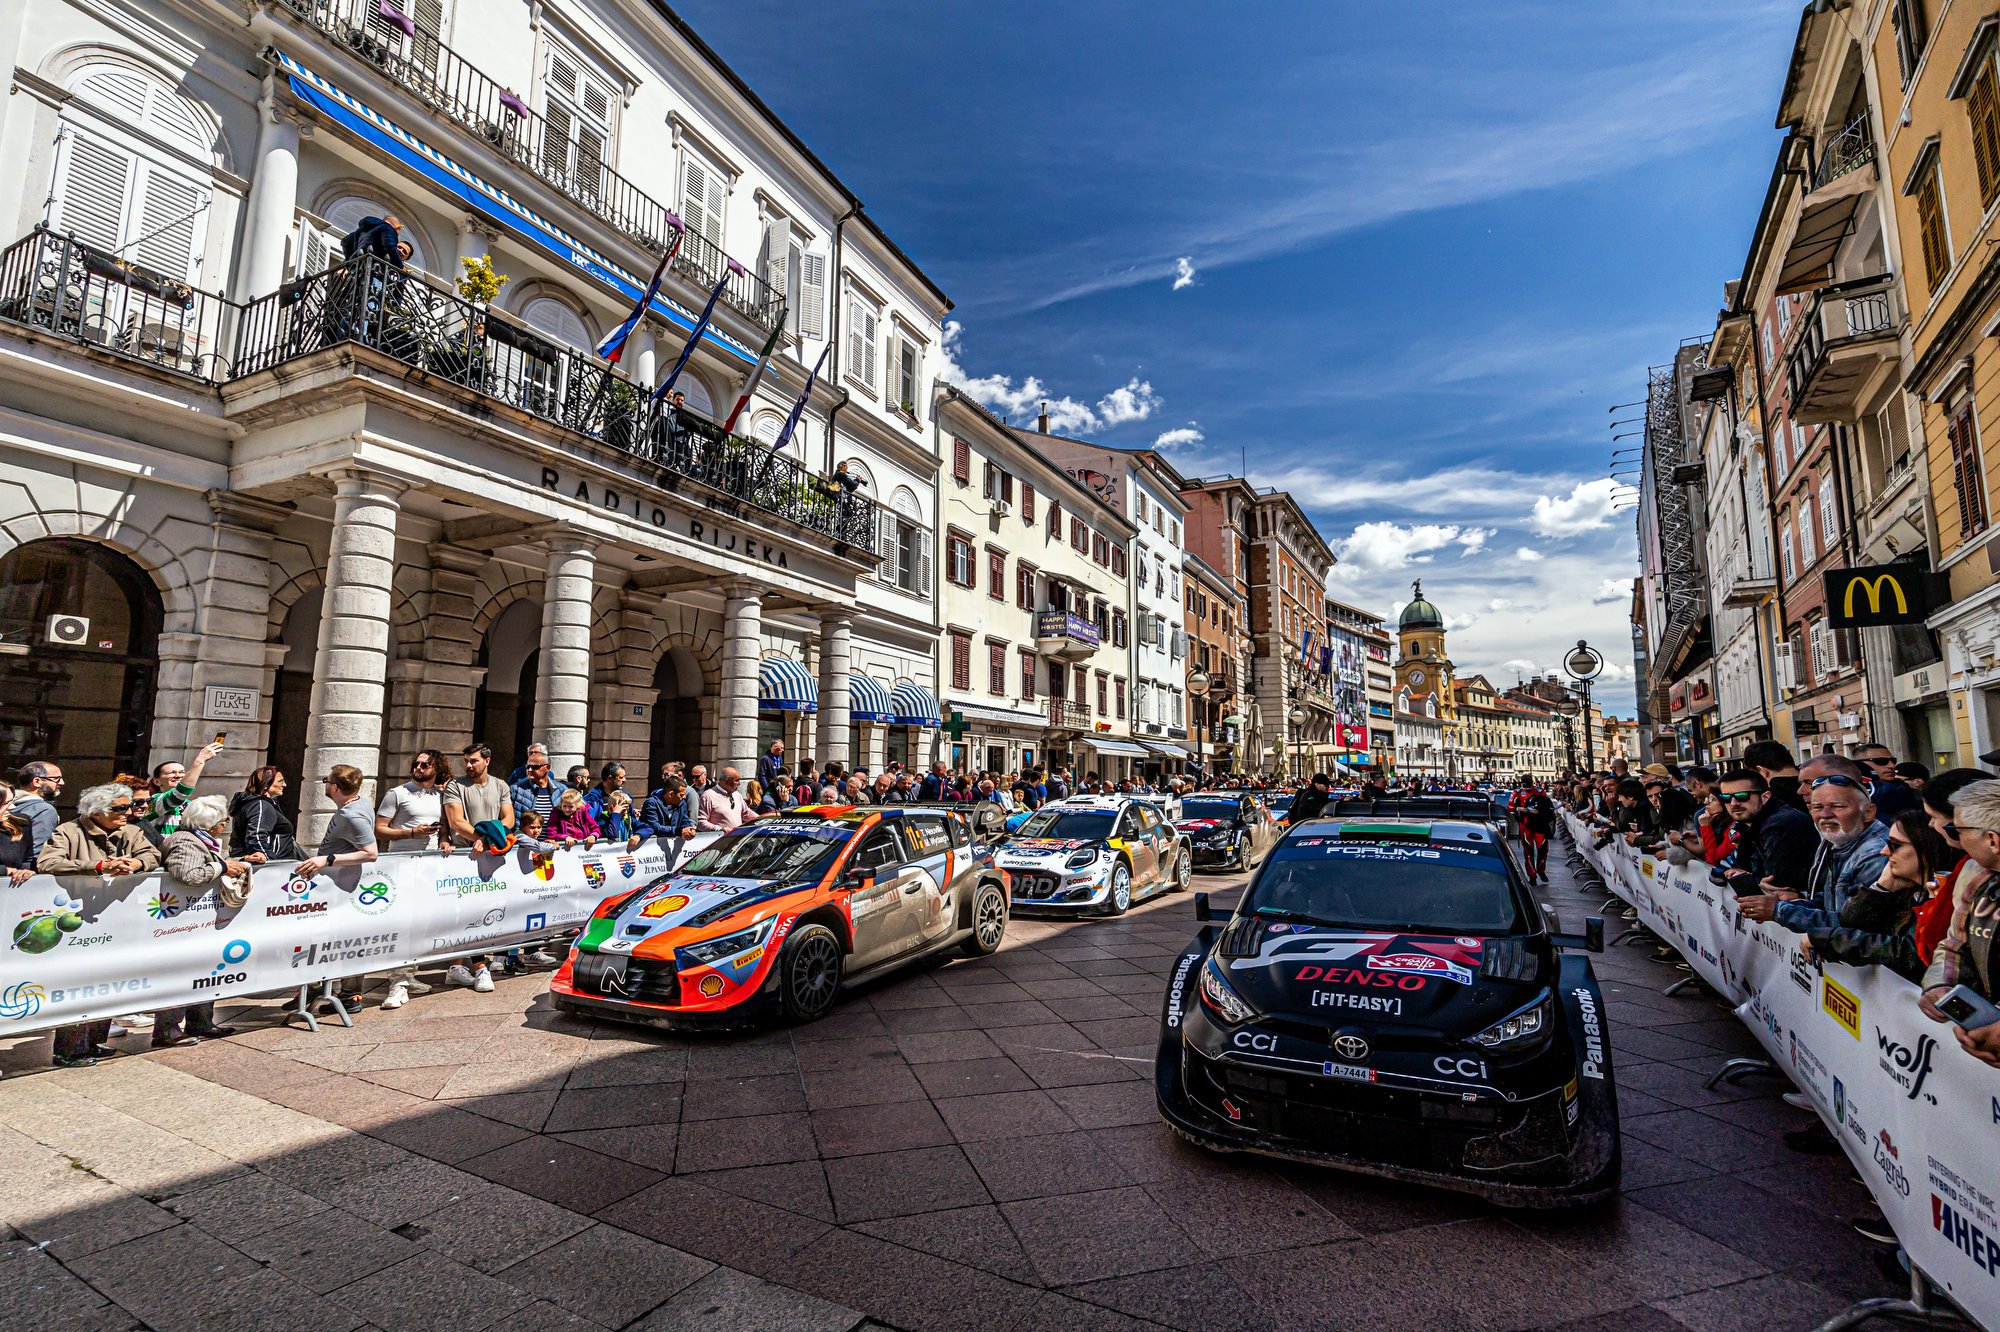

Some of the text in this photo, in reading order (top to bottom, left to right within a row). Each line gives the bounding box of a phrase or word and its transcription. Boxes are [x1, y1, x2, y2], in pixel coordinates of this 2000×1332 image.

[541, 466, 788, 569] RADIO RIJEKA
[1326, 846, 1441, 859] FORUM8
[1378, 840, 1428, 848] GAZOO
[1430, 843, 1479, 855] Racing
[436, 873, 494, 892] primorsko
[457, 879, 507, 898] goranska
[523, 884, 571, 894] Krapinsko-zagorska
[677, 881, 746, 896] MOBIS
[1072, 876, 1093, 885] Castrol
[185, 902, 225, 912] županija
[266, 901, 328, 917] KARLOVAC
[153, 923, 199, 938] Destinacija
[68, 933, 113, 948] Zagorje
[320, 932, 399, 952] HRVATSKE
[318, 944, 396, 965] AUTOCESTE
[735, 947, 763, 967] PIRELLI
[193, 971, 247, 990] mireo
[1295, 965, 1426, 991] DENSO
[1167, 953, 1200, 1028] Panasonic
[1312, 989, 1402, 1016] [FIT-EASY]
[1825, 981, 1858, 1031] PIRELLI
[1572, 987, 1604, 1080] Panasonic
[1334, 1066, 1366, 1078] A-7444
[1879, 1056, 1910, 1090] LUBRICANTS
[1873, 1135, 1910, 1197] Zagreb
[1927, 1154, 1961, 1189] ENTERING
[1961, 1178, 1976, 1200] THE
[1928, 1172, 1957, 1201] HYBRID
[1958, 1193, 1975, 1215] ERA
[1975, 1206, 1998, 1232] WITH
